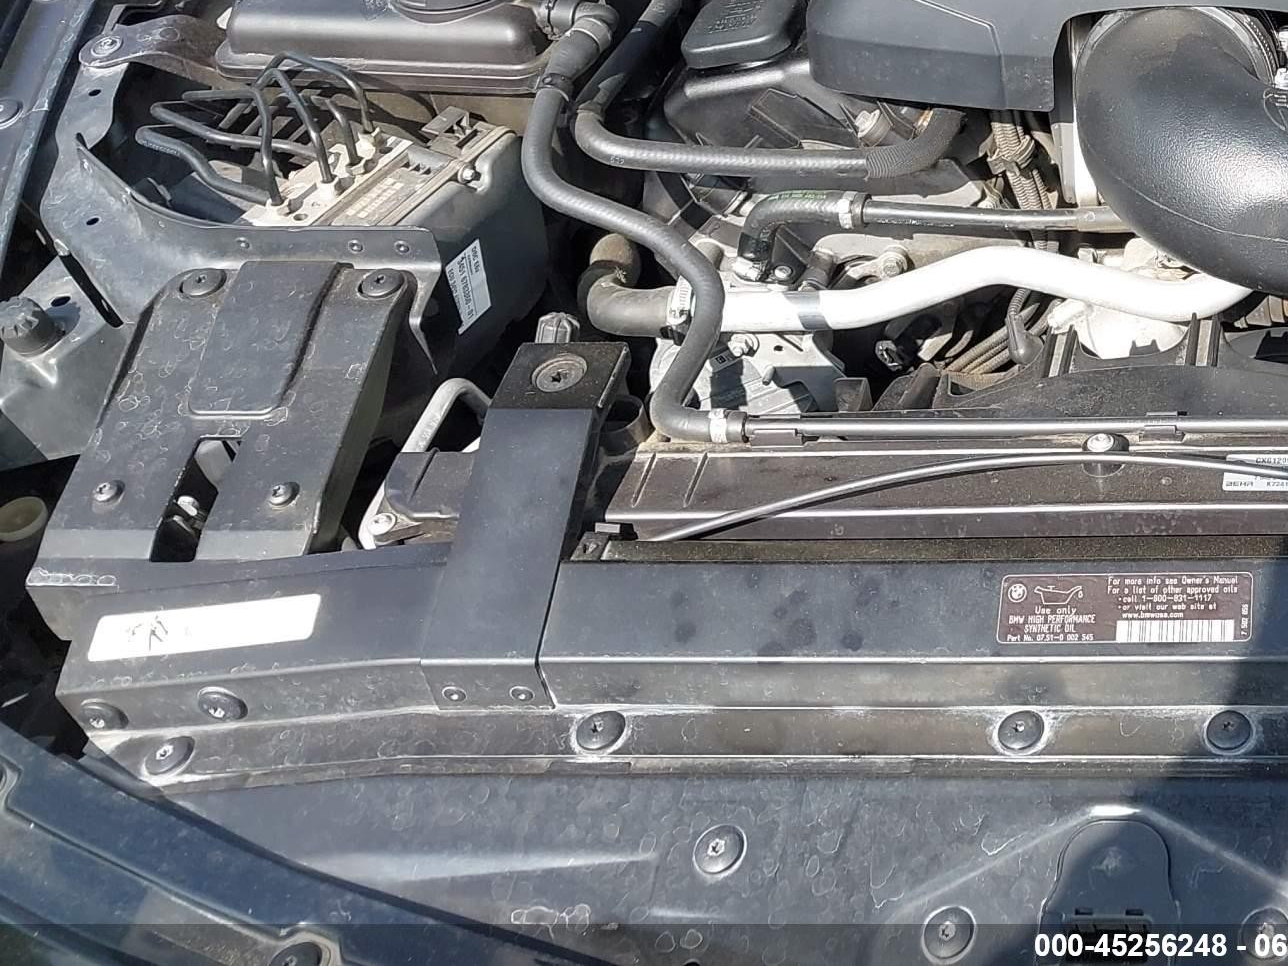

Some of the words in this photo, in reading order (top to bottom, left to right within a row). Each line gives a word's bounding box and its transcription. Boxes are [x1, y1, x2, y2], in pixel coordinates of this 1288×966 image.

[1108, 577, 1120, 585] For
[1182, 576, 1209, 584] Owner's
[1214, 576, 1238, 584] Manual
[1107, 586, 1120, 594] For
[1133, 586, 1146, 594] list
[1150, 586, 1158, 594] of
[1163, 586, 1182, 596] other
[1187, 585, 1219, 595] approved
[1123, 595, 1137, 603] call
[1035, 606, 1051, 614] Use
[1057, 606, 1077, 616] only
[1009, 616, 1024, 624] BMW
[1028, 615, 1045, 623] HIGH
[1048, 615, 1096, 624] PERFORMANCE
[1024, 624, 1060, 633] SYNTHETIC
[1064, 624, 1076, 632] OIL
